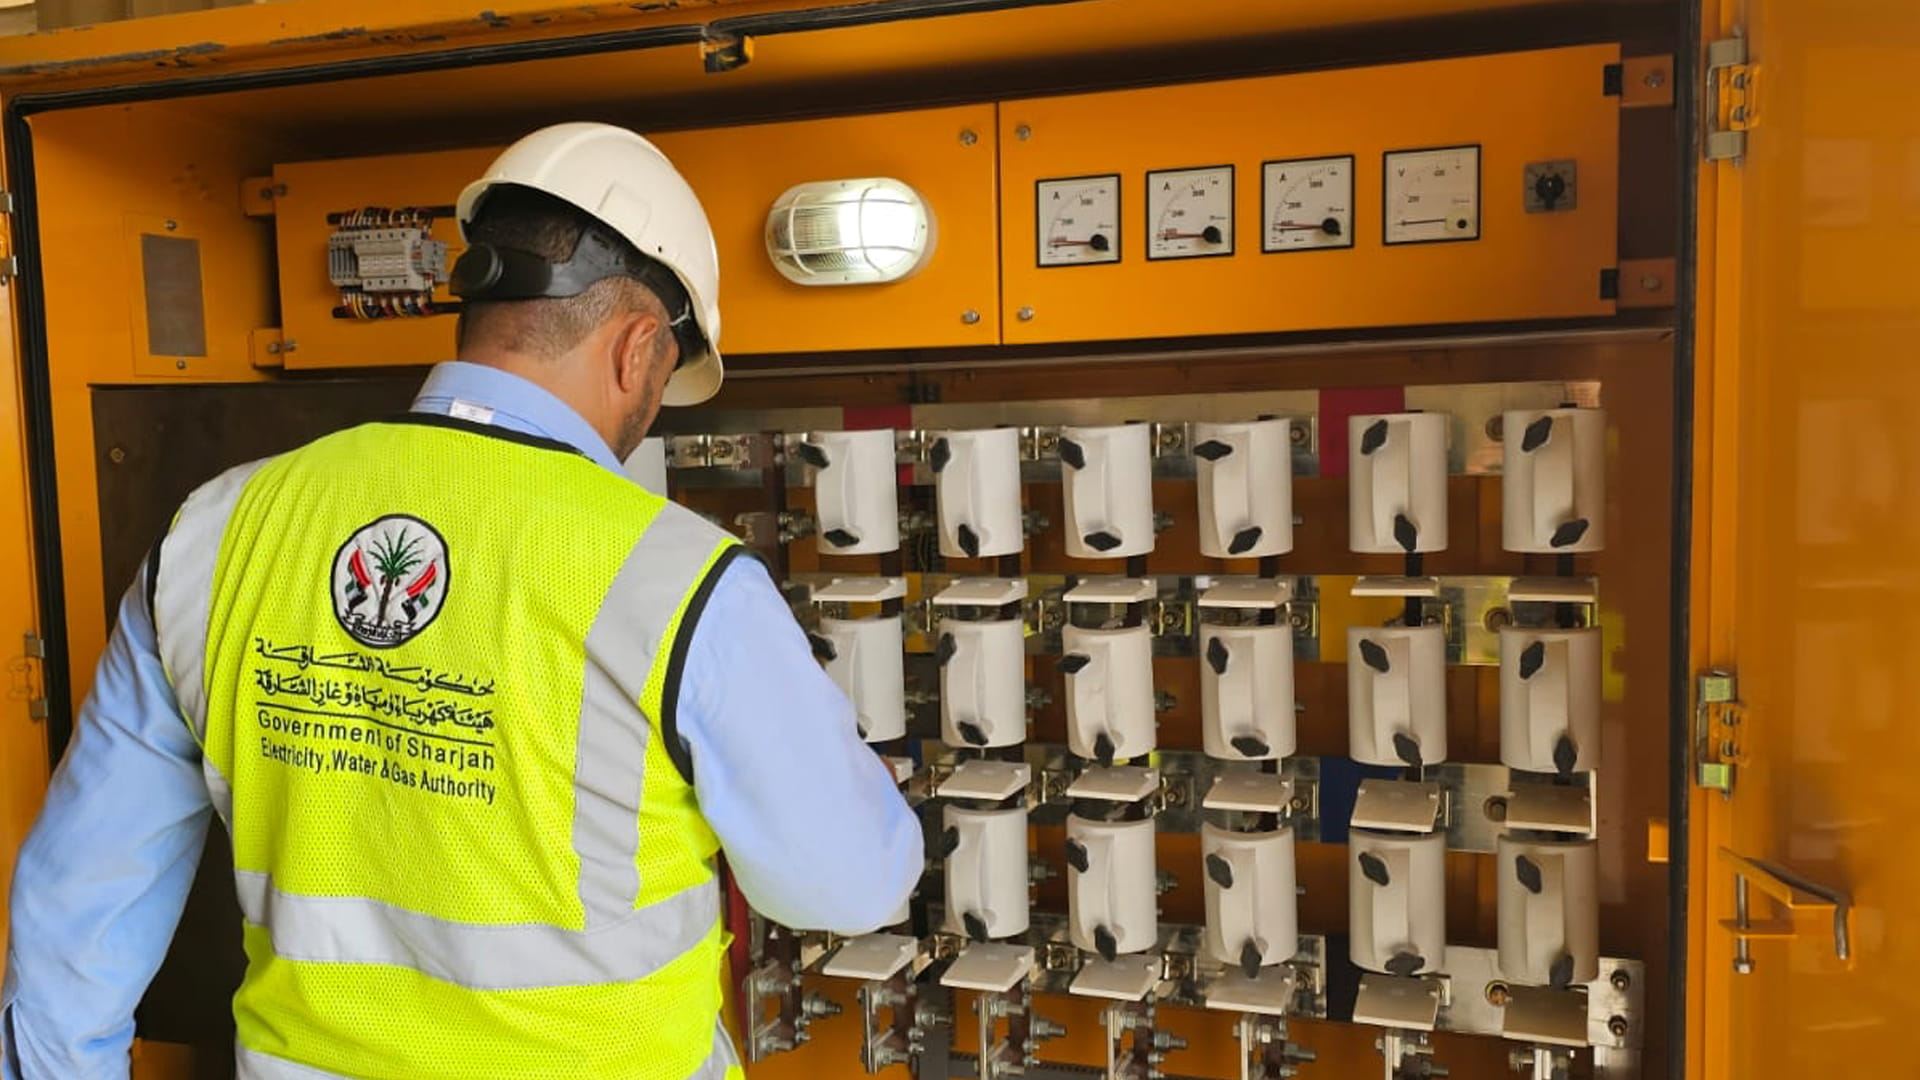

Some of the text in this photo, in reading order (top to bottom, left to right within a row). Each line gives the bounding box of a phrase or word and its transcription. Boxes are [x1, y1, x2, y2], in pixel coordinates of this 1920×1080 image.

[1053, 191, 1061, 201] A
[1163, 181, 1171, 191] A
[258, 709, 494, 771] Government of Sharjah
[332, 749, 378, 777] Water
[391, 762, 417, 787] Gas
[420, 770, 496, 805] Authority
